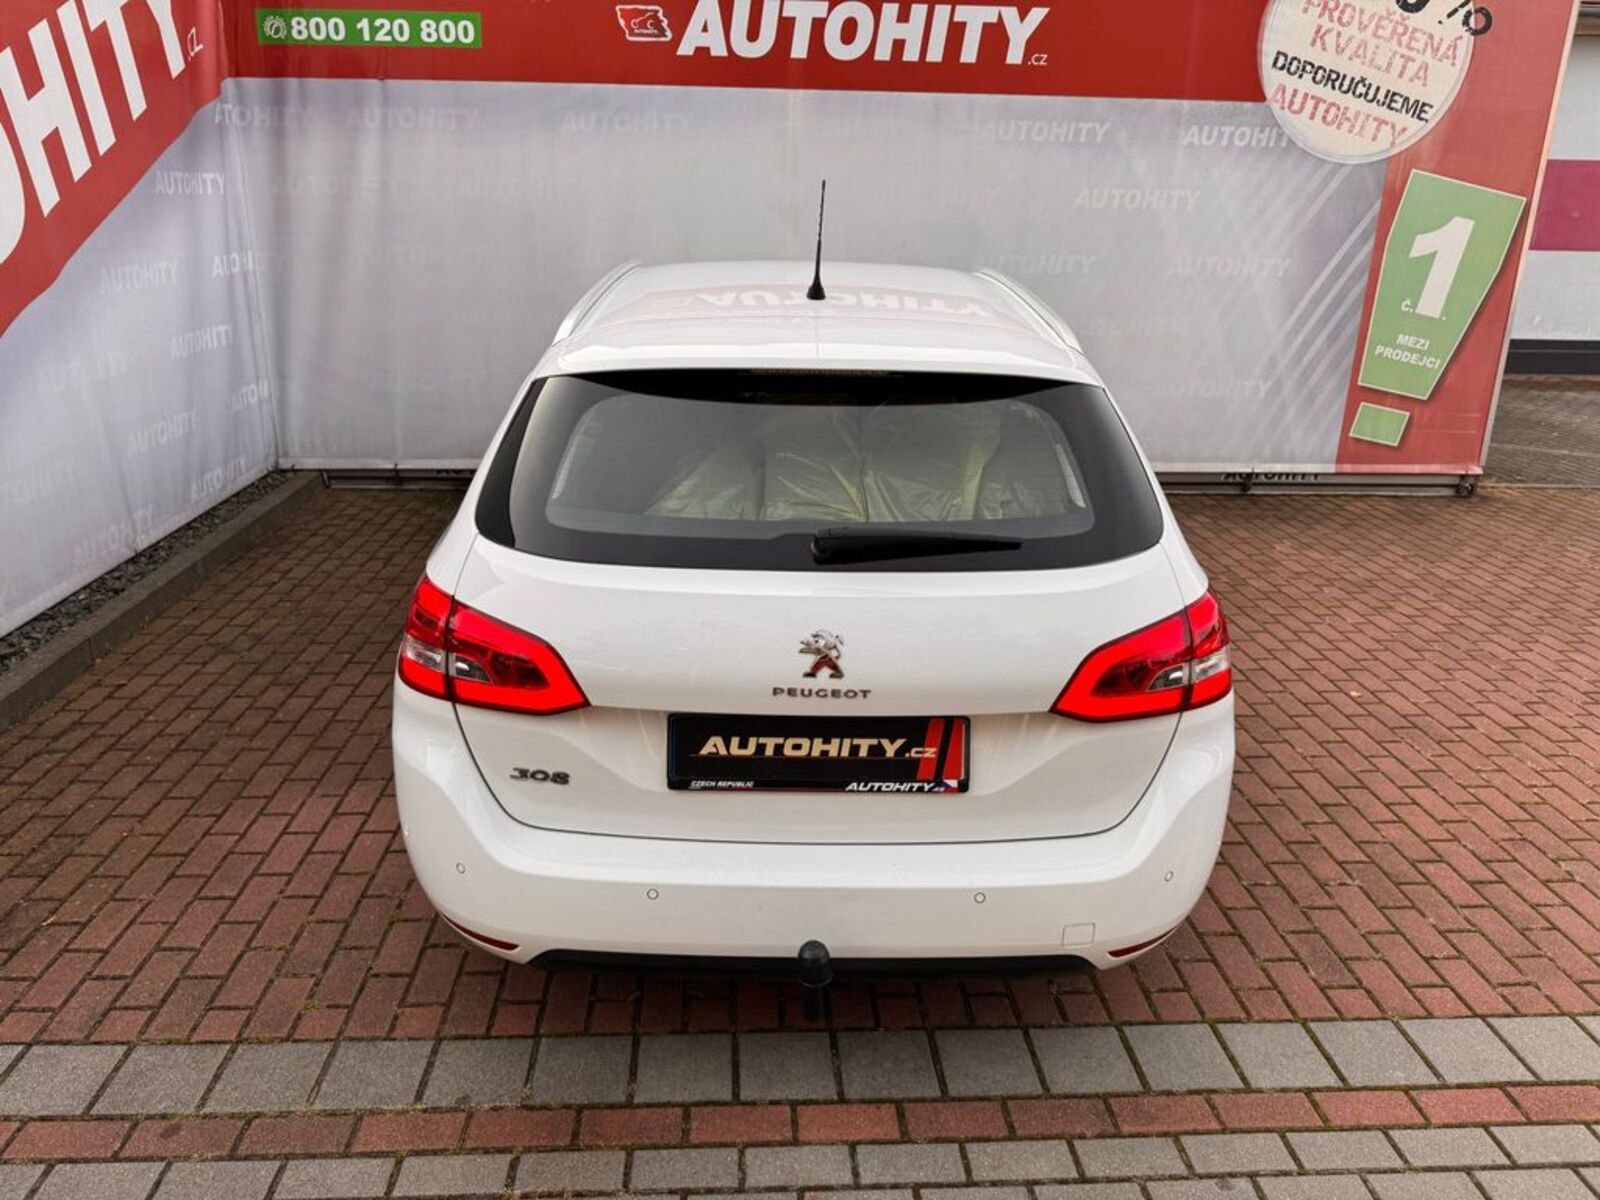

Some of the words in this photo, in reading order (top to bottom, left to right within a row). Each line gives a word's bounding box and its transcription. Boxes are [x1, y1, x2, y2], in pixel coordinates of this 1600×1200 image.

[291, 16, 346, 41] 800
[356, 18, 410, 42] 120
[420, 19, 475, 43] 800
[1309, 23, 1431, 87] KVALITA
[1271, 50, 1435, 123] DOPORUČUJEME
[346, 106, 482, 129] AUTOHITY
[1272, 82, 1408, 148] AUTOHITY
[978, 119, 1112, 142] AUTOHITY
[155, 170, 225, 196] AUTOHITY
[1073, 188, 1201, 211] AUTOHITY
[101, 258, 178, 295] AUTOHITY
[1167, 256, 1292, 279] AUTOHITY
[1396, 333, 1431, 351] MEZI
[1375, 344, 1441, 369] PRODEJCI
[772, 686, 872, 700] PEUGEOT
[509, 767, 570, 786] 308
